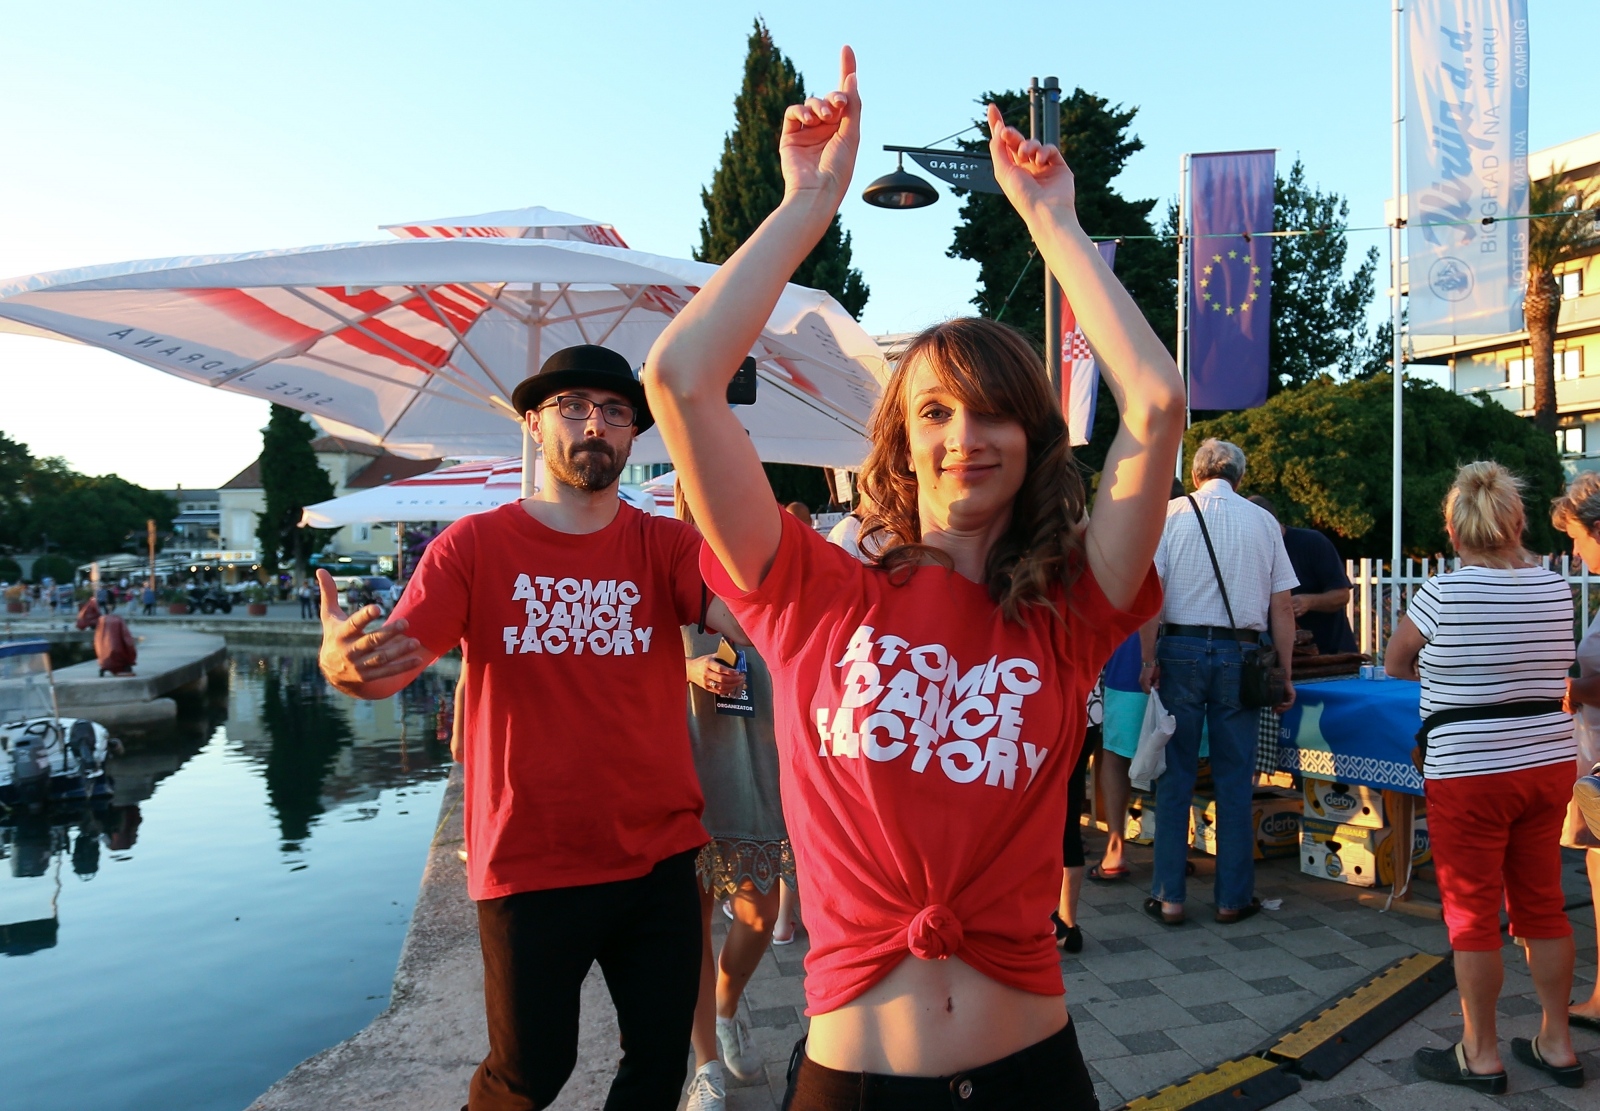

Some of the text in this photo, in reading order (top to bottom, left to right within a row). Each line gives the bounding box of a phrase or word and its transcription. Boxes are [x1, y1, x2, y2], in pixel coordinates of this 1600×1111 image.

[1440, 21, 1473, 90] d.d.
[1480, 28, 1500, 253] BIOGRAD NA MORU
[1512, 19, 1528, 294] HOTELS MARINA CAMPING
[511, 573, 642, 606] ATOMIC
[503, 626, 653, 656] FACTORY
[525, 600, 634, 631] DANCE
[834, 625, 1042, 700] ATOMIC
[716, 703, 753, 711] ORGANIZATOR
[841, 661, 1024, 742] DANCE
[816, 707, 1048, 792] FACTORY
[1265, 813, 1300, 833] derb
[1325, 793, 1355, 810] derby
